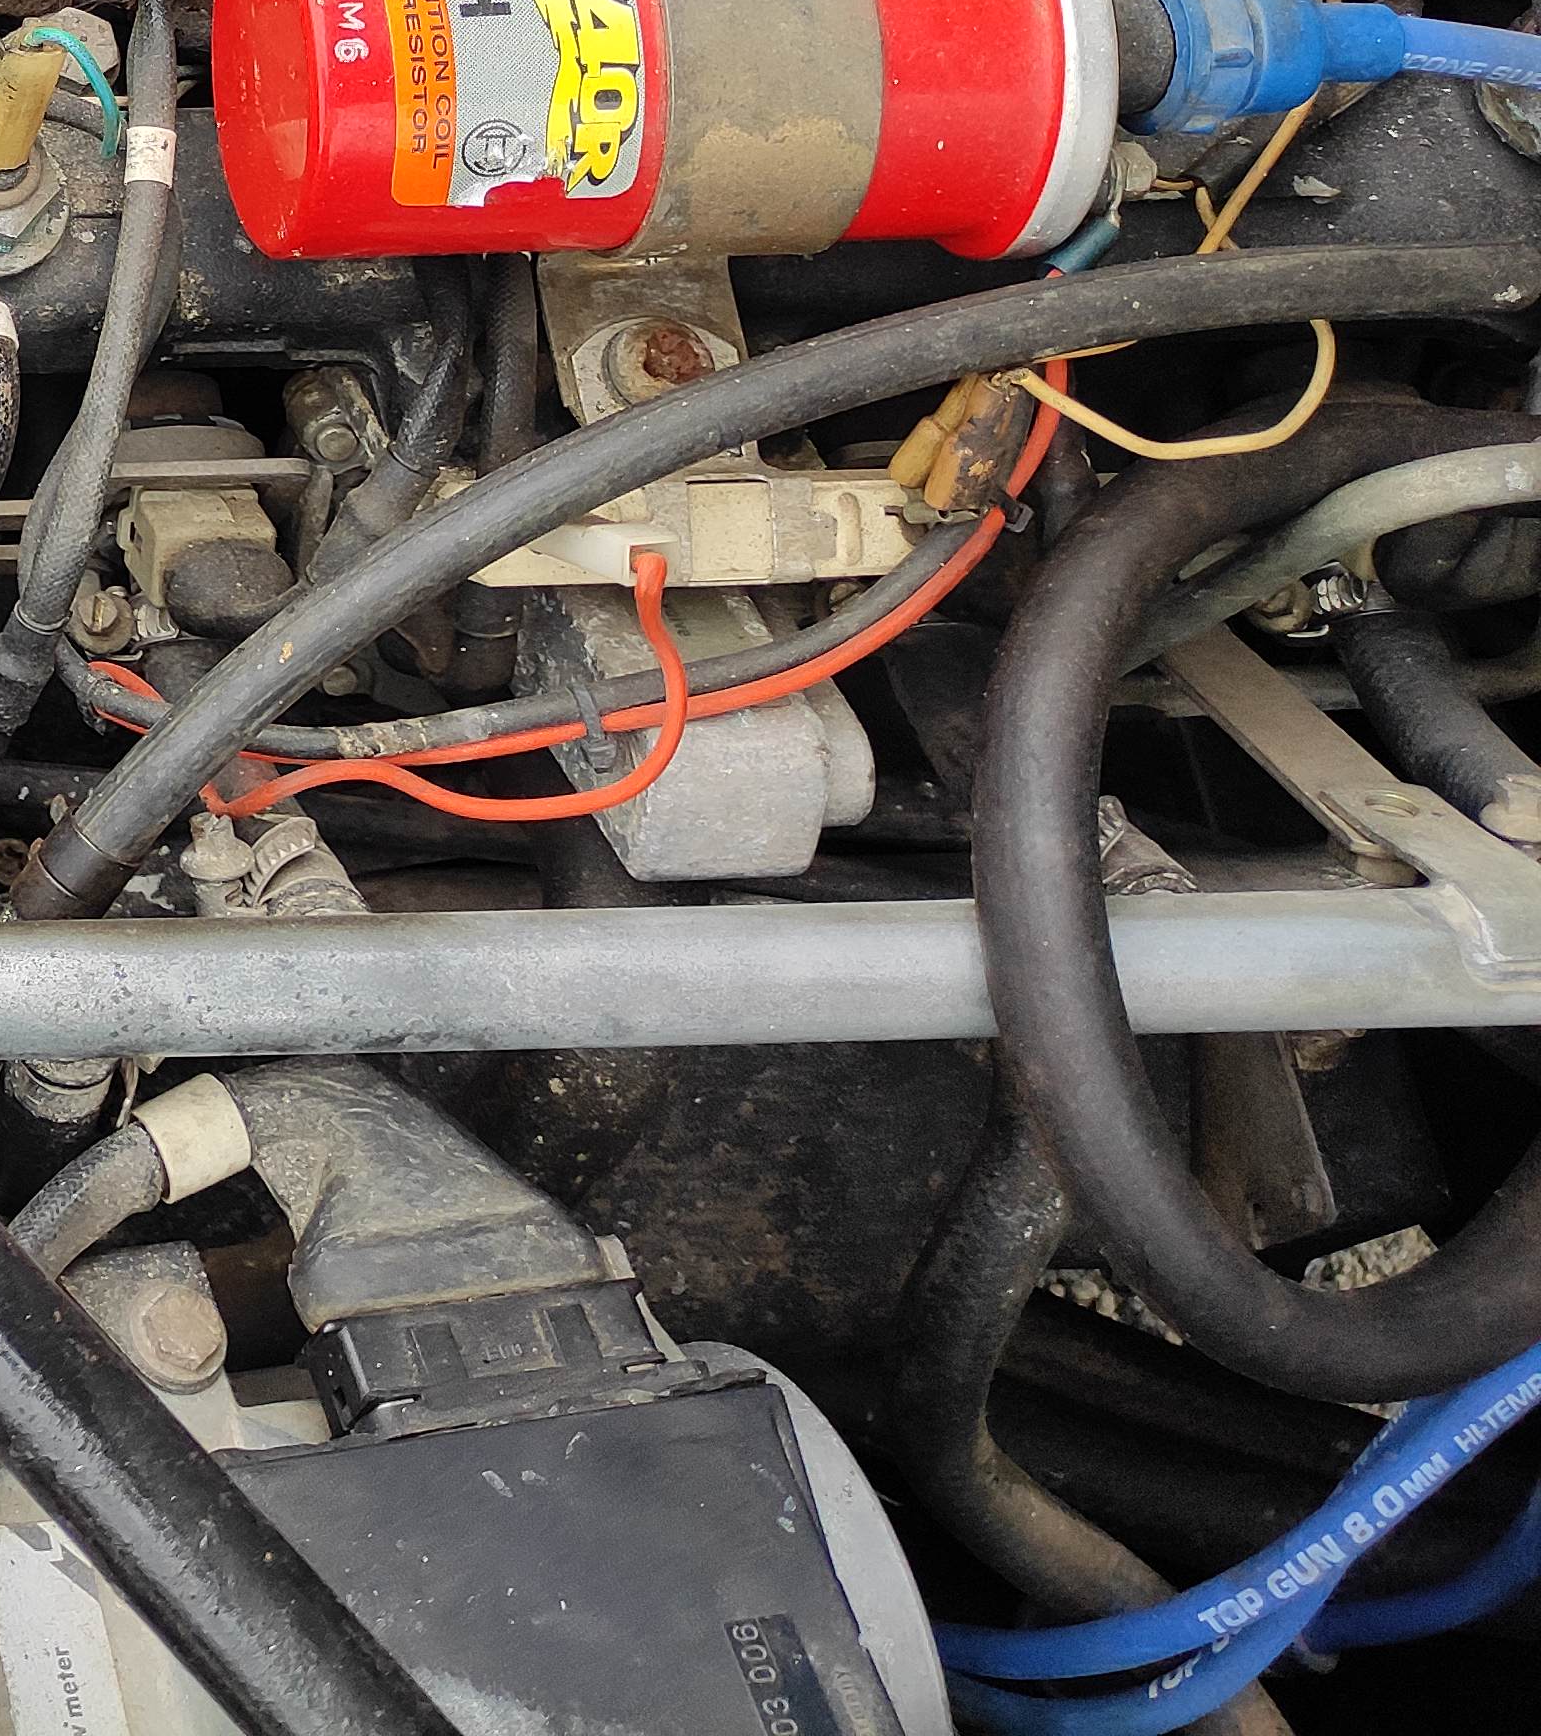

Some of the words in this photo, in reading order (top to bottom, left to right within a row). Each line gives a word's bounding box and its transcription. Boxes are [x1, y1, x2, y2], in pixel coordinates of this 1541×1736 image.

[433, 94, 452, 170] COIL
[1196, 1587, 1264, 1635] TOP
[1267, 1533, 1348, 1600] GUN
[54, 1645, 84, 1718] meter
